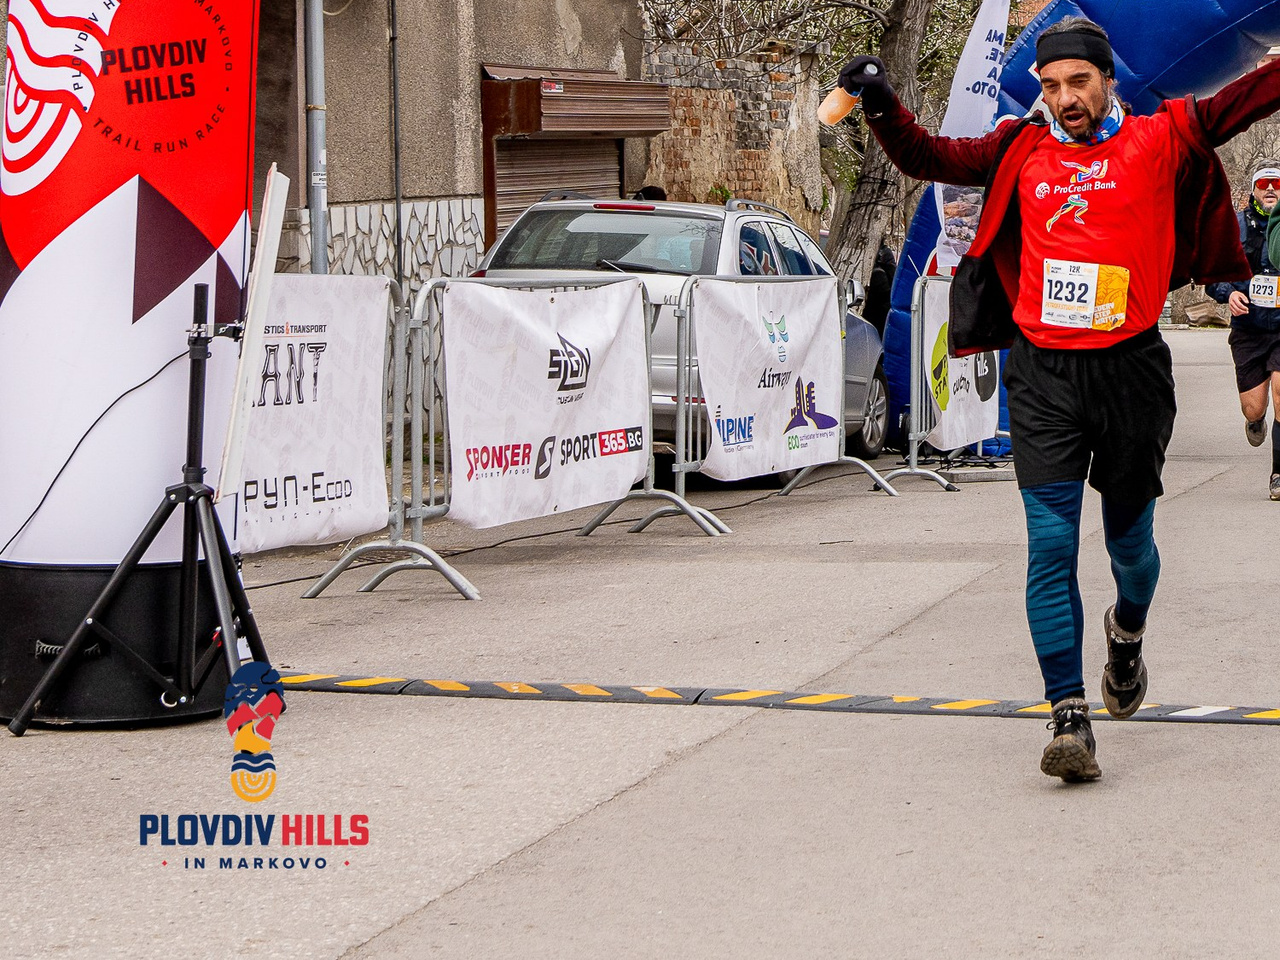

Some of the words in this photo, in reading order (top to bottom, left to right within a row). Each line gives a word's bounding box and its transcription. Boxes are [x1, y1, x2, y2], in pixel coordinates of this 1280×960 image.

[71, 12, 99, 91] PLOVDIV
[100, 38, 207, 76] PLOVDIV
[125, 73, 196, 106] HILLS
[93, 118, 141, 152] TRAIL
[154, 138, 188, 153] RUN
[196, 104, 225, 140] RACE
[1053, 183, 1093, 194] ProCredit
[1094, 180, 1117, 191] Bank
[1047, 279, 1089, 304] 1232
[1252, 283, 1274, 296] 1273
[290, 324, 328, 335] TRANSPORT
[252, 342, 328, 407] ANT
[465, 443, 532, 482] SPONSER
[560, 432, 598, 467] SPORT
